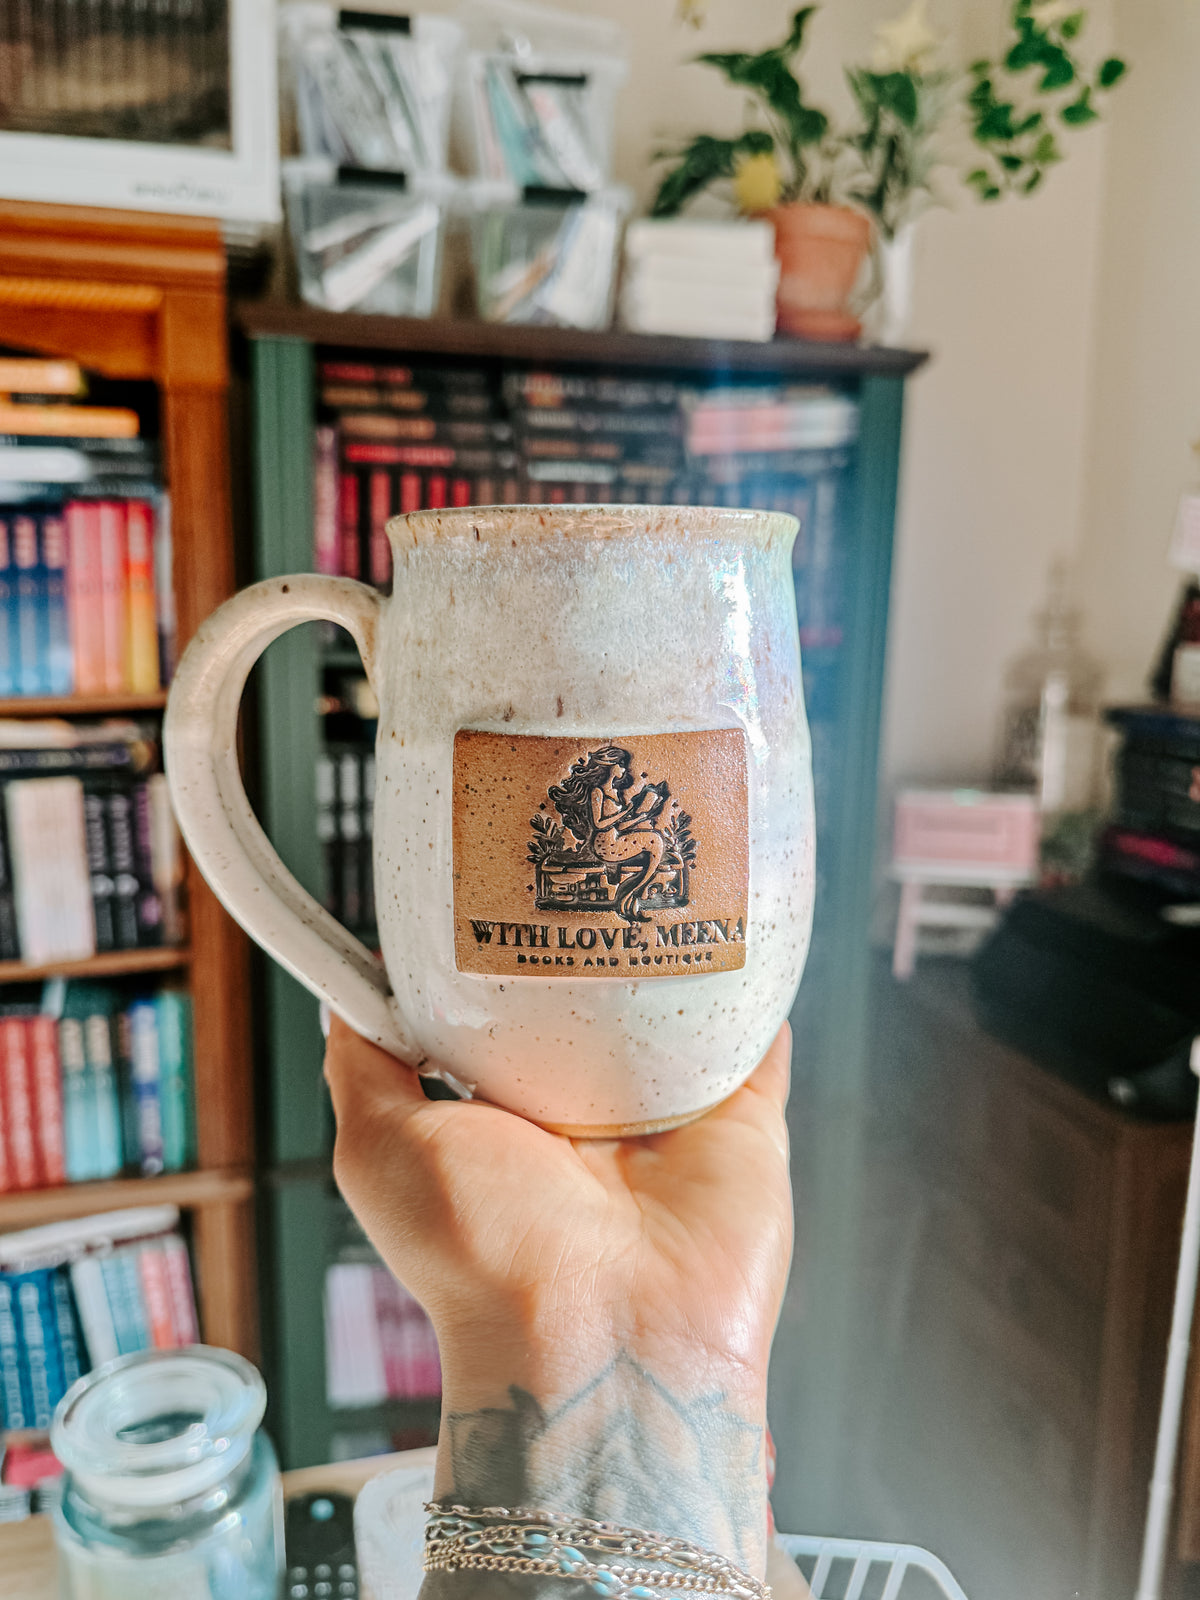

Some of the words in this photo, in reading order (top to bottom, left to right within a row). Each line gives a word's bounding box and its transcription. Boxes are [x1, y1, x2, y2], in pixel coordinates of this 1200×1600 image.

[470, 919, 550, 948] WITH
[557, 926, 648, 951] LOVE,
[656, 917, 745, 947] MEENA
[517, 953, 574, 966] BOOKS
[583, 956, 619, 967] AND
[629, 952, 712, 966] BOUTIQUE
